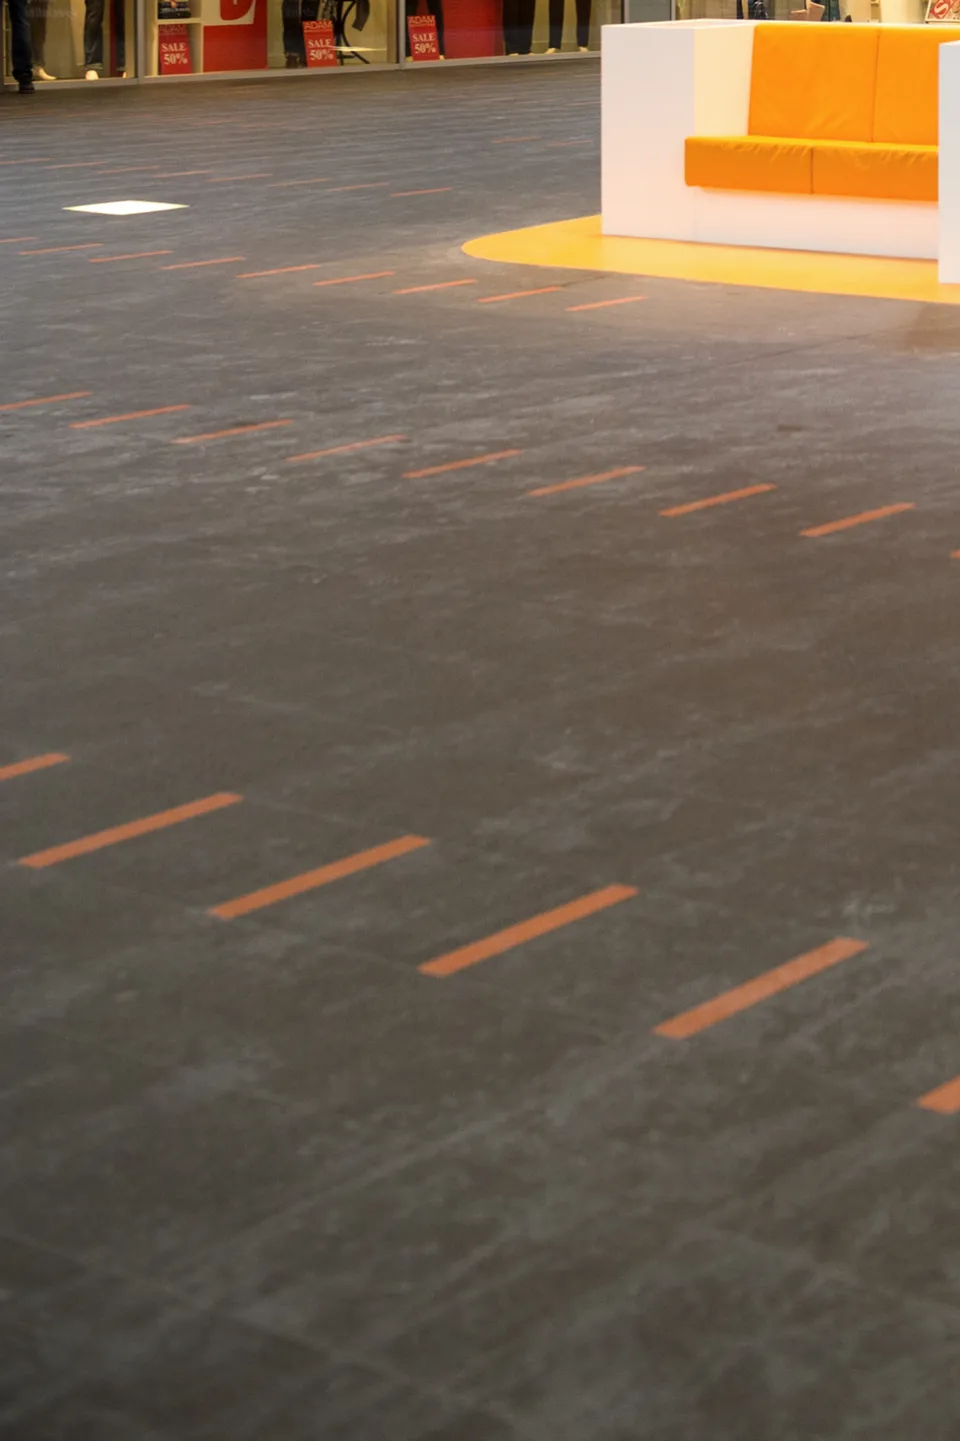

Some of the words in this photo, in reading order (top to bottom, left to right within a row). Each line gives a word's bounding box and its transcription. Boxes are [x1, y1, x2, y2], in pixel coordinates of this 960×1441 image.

[412, 32, 435, 43] SALE
[160, 42, 188, 53] SALE
[307, 39, 333, 49] SALE
[414, 42, 437, 54] 50%
[163, 52, 189, 65] 50%
[310, 49, 335, 61] 50%
